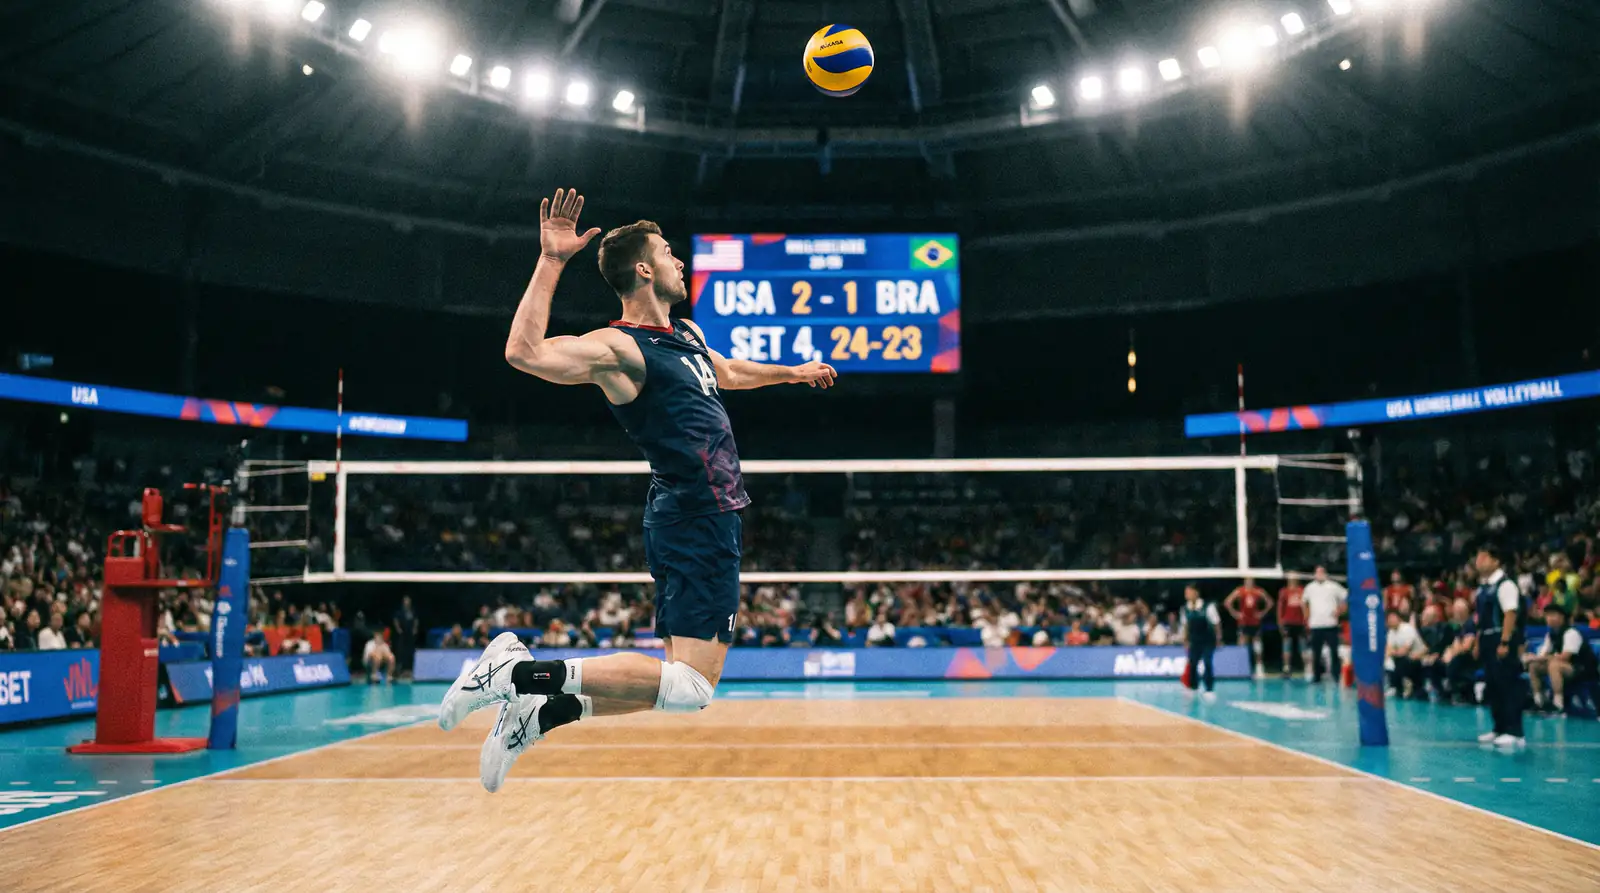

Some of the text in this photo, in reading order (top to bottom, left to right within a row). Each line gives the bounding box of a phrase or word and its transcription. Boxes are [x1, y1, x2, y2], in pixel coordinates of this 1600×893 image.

[714, 280, 940, 315] USA 2 - 1 BRA
[730, 326, 786, 361] SET
[830, 326, 922, 360] 24-23
